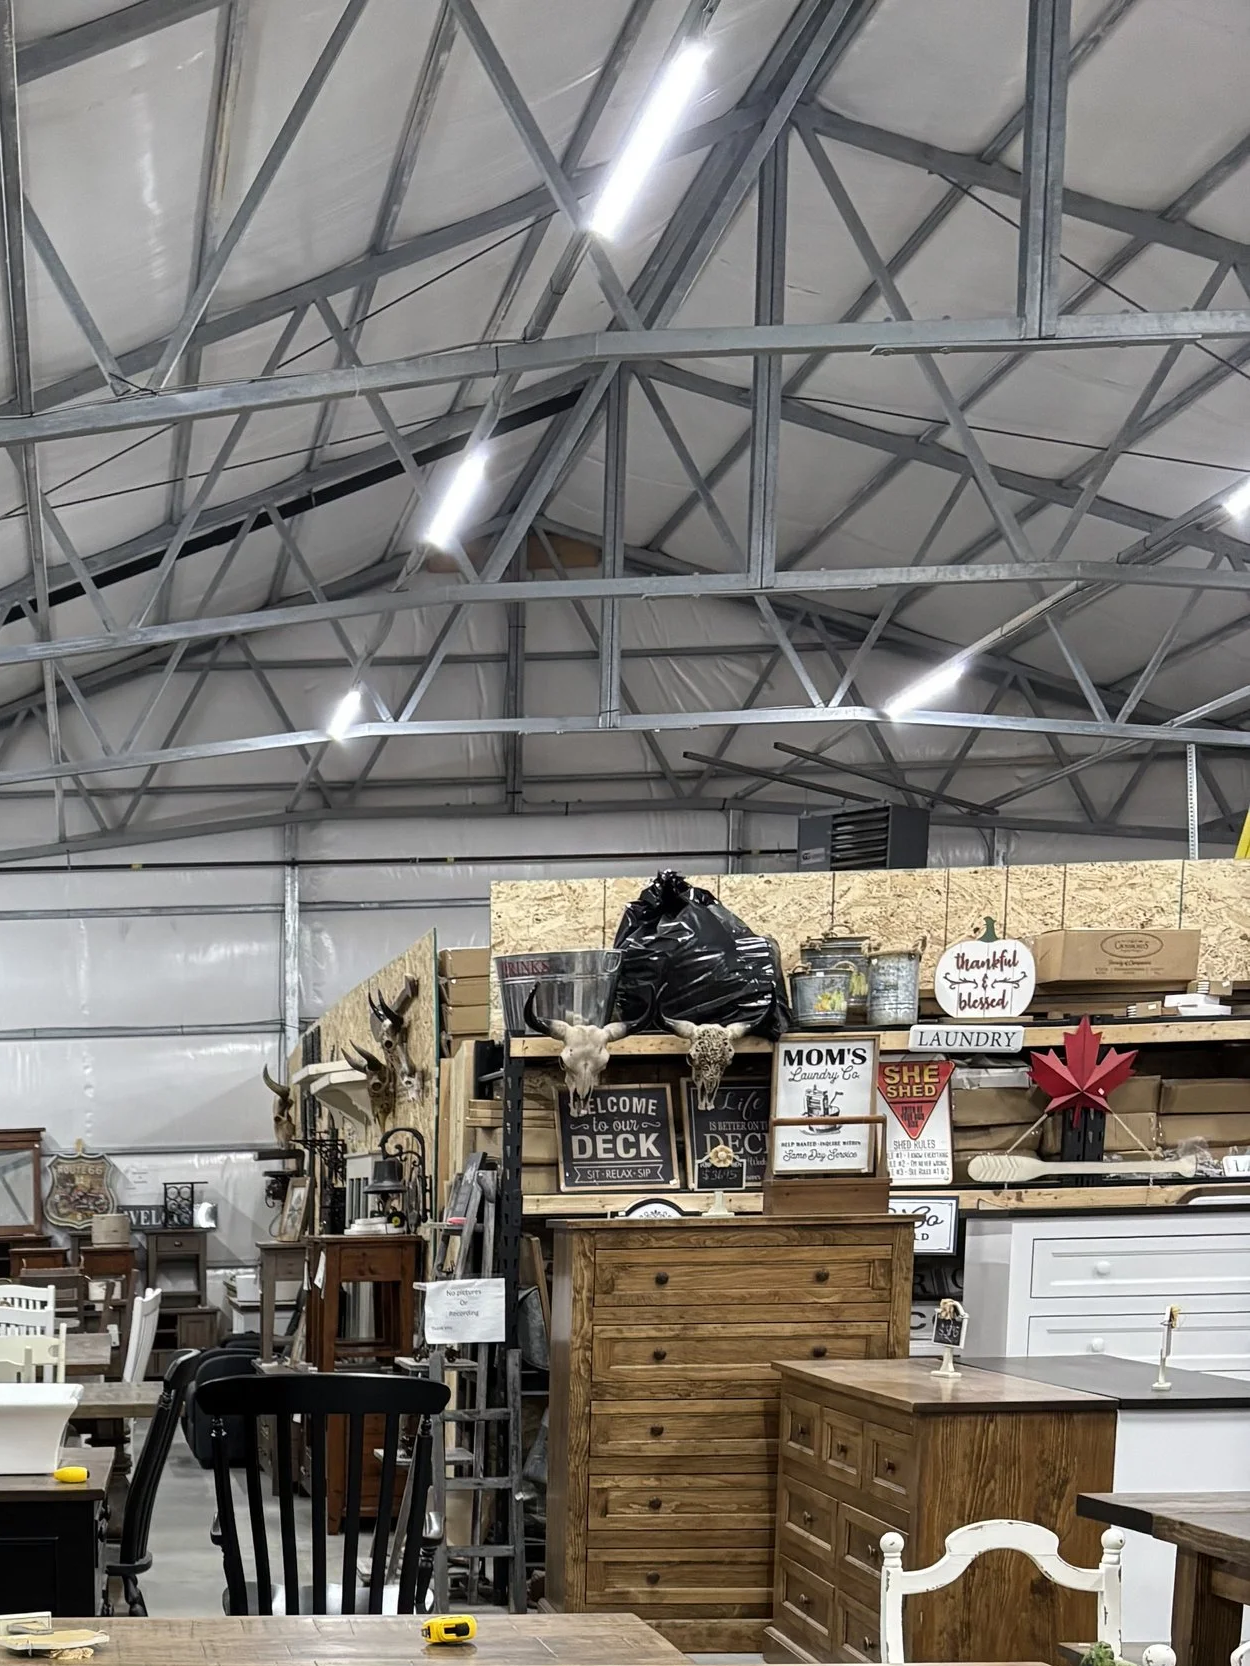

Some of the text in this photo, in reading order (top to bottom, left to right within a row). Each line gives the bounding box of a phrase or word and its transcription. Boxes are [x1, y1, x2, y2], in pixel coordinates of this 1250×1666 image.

[954, 949, 1019, 972] thankful
[958, 989, 1008, 1011] blessed
[918, 1031, 1016, 1047] LAUNDRY
[783, 1048, 867, 1066] MOM'S
[788, 1067, 839, 1084] Laundry
[883, 1065, 940, 1084] SHE
[886, 1084, 936, 1098] SHED
[569, 1096, 658, 1116] ELCOME
[720, 1091, 764, 1120] Life
[592, 1117, 640, 1132] to our
[718, 1121, 748, 1131] BETTER
[571, 1132, 661, 1160] DECK
[783, 1148, 858, 1162] Same Day Service
[587, 1167, 652, 1180] SIT RELAX SIP
